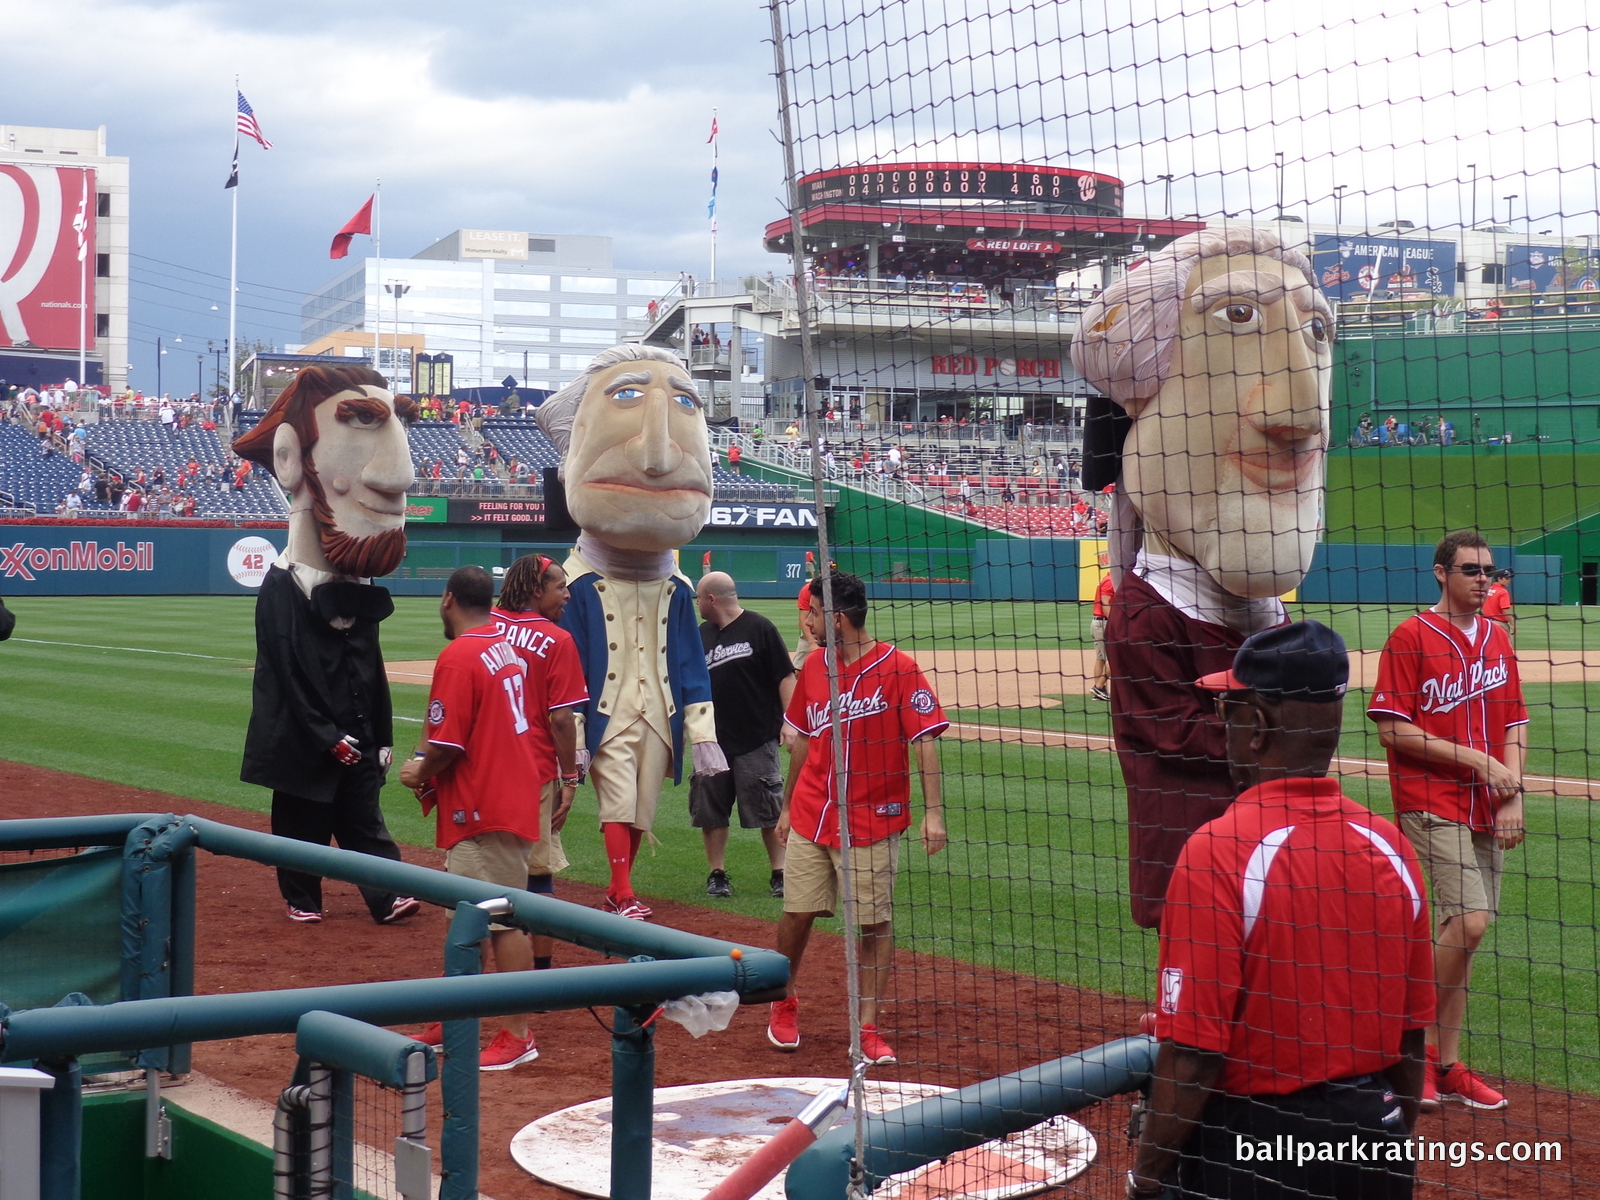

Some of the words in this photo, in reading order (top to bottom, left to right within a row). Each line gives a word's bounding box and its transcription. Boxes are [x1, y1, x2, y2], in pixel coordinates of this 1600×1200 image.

[849, 175, 856, 186] 0
[862, 173, 869, 184] 0
[877, 172, 884, 183] 0
[892, 171, 900, 182] 0
[908, 171, 917, 181] 0
[961, 171, 969, 181] 0
[978, 171, 987, 181] 0
[1012, 172, 1018, 183] 1
[1032, 174, 1040, 185] 6
[1053, 175, 1060, 186] 0
[849, 186, 856, 197] 0
[862, 184, 870, 196] 4
[908, 182, 917, 193] 0
[925, 182, 934, 193] 0
[943, 182, 951, 193] 0
[960, 182, 969, 193] 0
[978, 182, 986, 193] X
[1010, 184, 1019, 194] 4
[1030, 185, 1043, 196] 10
[1053, 187, 1060, 198] 0
[469, 231, 506, 241] LEASE
[493, 248, 508, 256] Realty
[986, 241, 1011, 250] RED
[1012, 241, 1042, 251] LOFT
[1355, 244, 1399, 258] AMERCAN
[1402, 247, 1434, 260] EAGUE
[931, 355, 979, 375] RED
[479, 502, 508, 511] FEELING
[509, 503, 524, 511] FOR
[525, 503, 540, 511] YOU
[704, 507, 747, 526] 6.7
[0, 541, 154, 580] xxonMobil
[242, 554, 264, 570] 42
[785, 563, 802, 579] 377
[713, 641, 751, 661] Service
[1420, 673, 1464, 712] Nat
[1470, 654, 1508, 692] Pack
[806, 700, 831, 732] Nat
[838, 685, 883, 716] Pack
